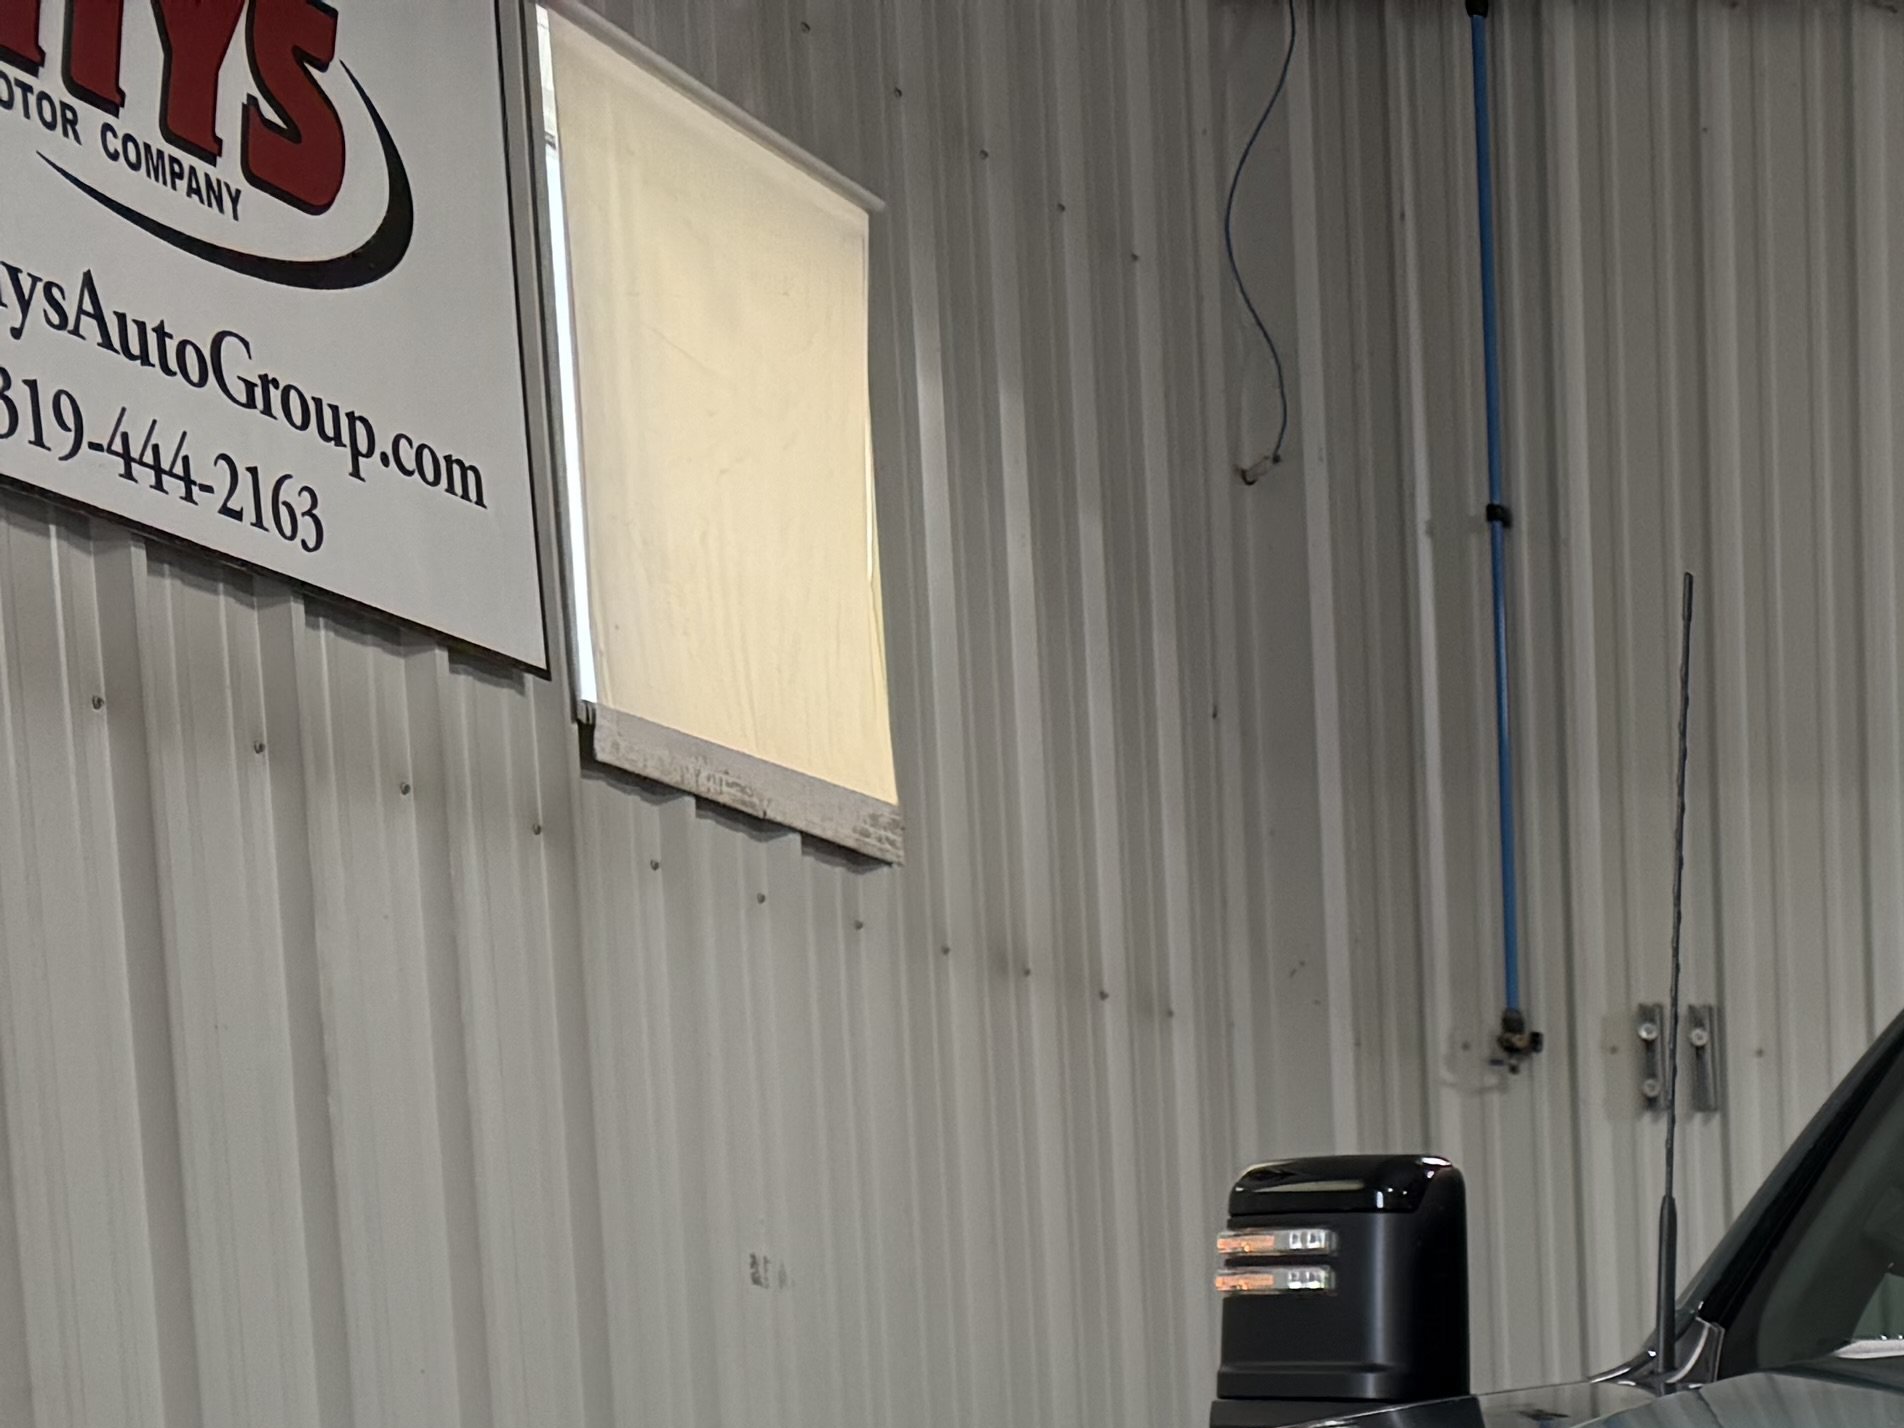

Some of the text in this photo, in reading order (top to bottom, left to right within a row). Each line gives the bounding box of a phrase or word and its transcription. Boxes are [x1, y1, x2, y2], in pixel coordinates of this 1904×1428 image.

[100, 122, 242, 222] COMPANY
[0, 261, 488, 509] ysAutoGroup.com
[0, 366, 325, 554] 319-444-2163
